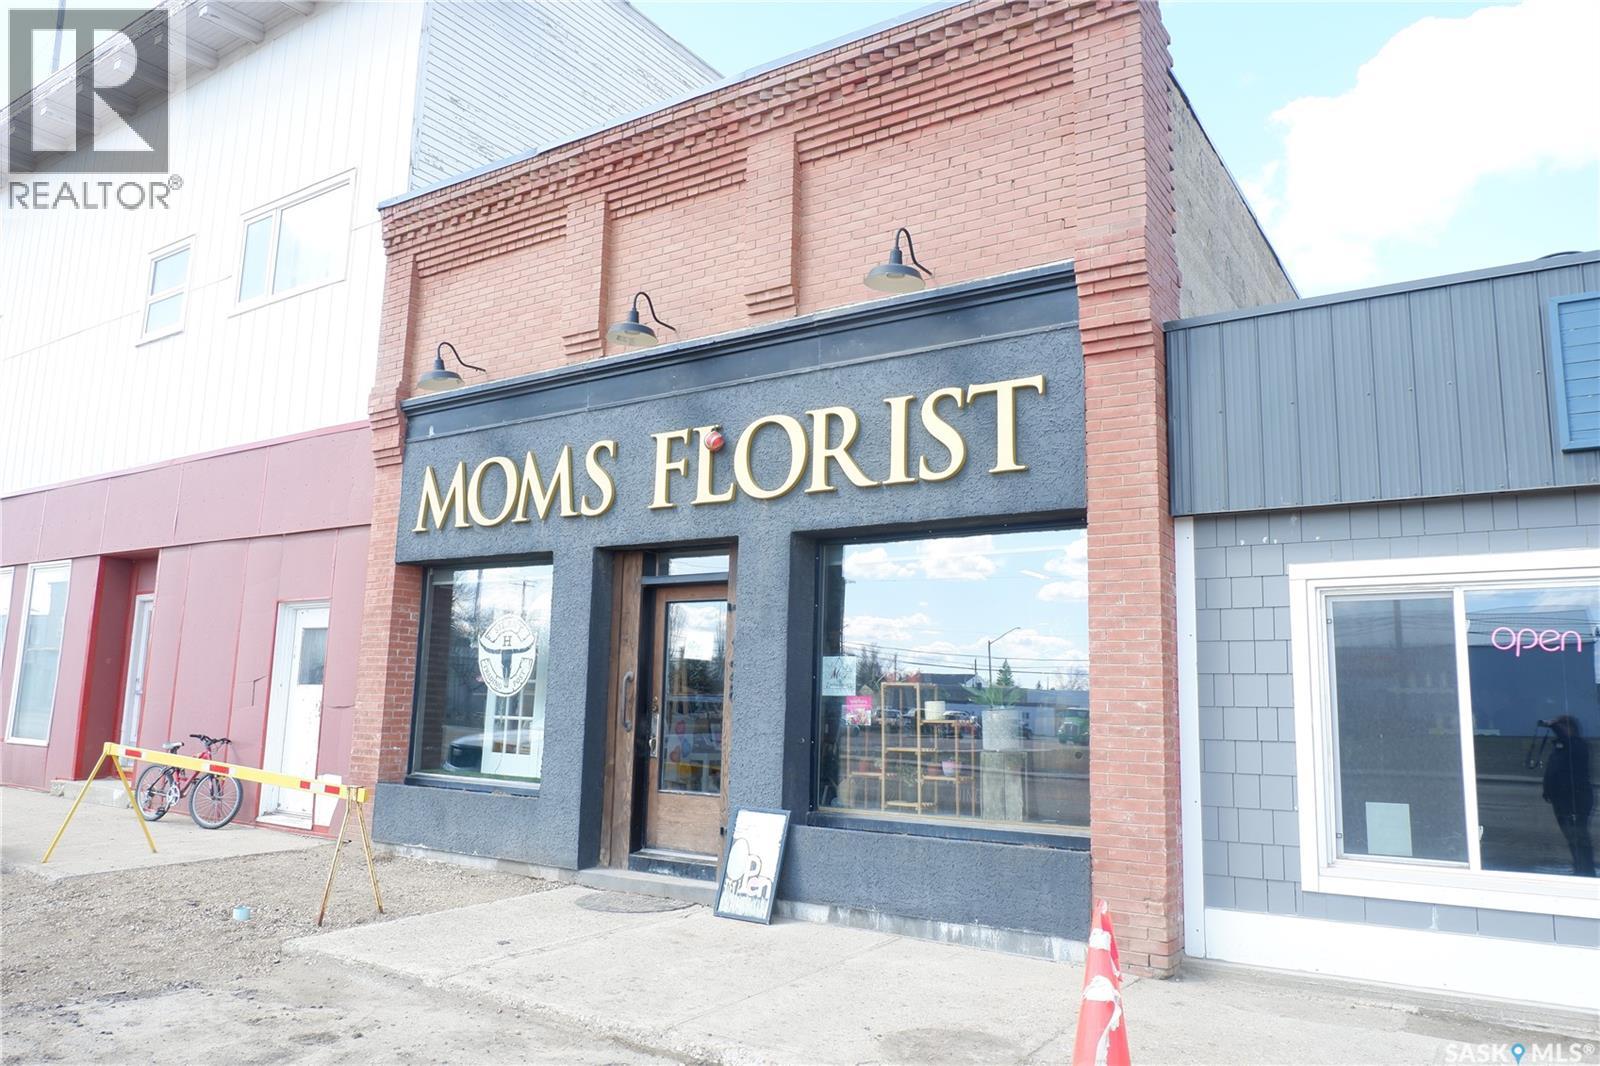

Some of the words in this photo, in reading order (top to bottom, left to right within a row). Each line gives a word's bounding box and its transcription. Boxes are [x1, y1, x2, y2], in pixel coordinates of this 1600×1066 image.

[412, 438, 618, 534] MOMS
[648, 374, 1046, 511] FLORIST
[503, 635, 512, 647] H
[1490, 626, 1583, 657] open
